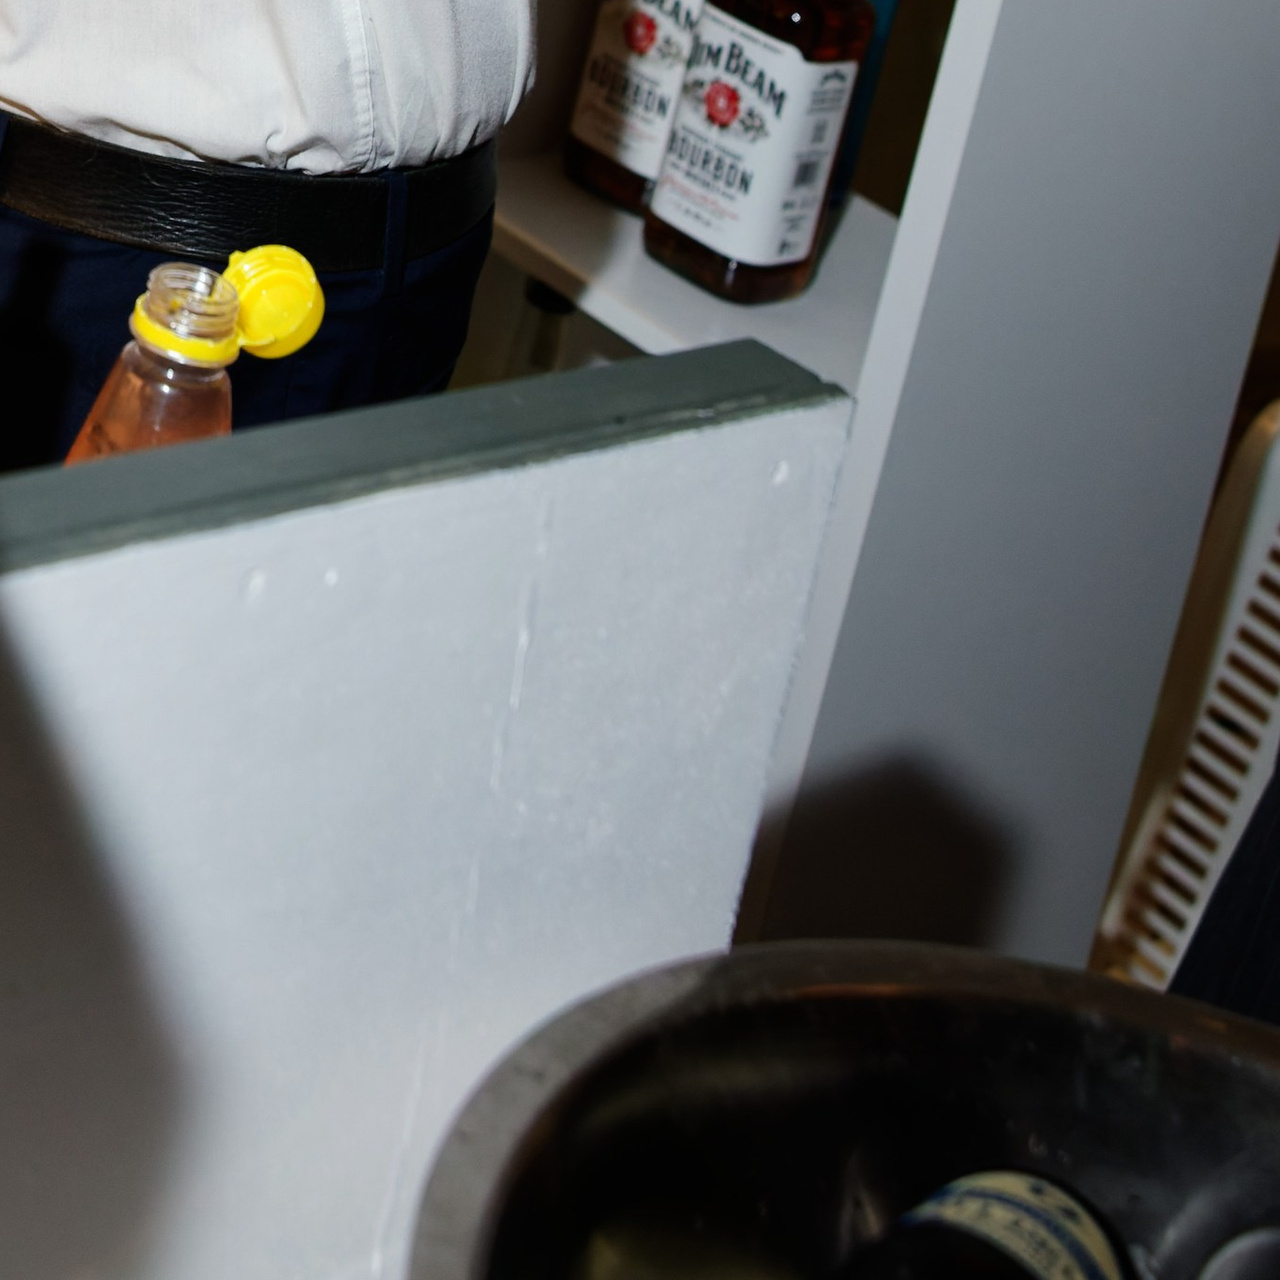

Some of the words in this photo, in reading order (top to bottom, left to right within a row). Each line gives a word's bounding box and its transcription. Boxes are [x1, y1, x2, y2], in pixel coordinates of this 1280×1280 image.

[686, 34, 723, 69] JIM
[725, 41, 786, 118] BEAM
[668, 127, 754, 195] BOURBON
